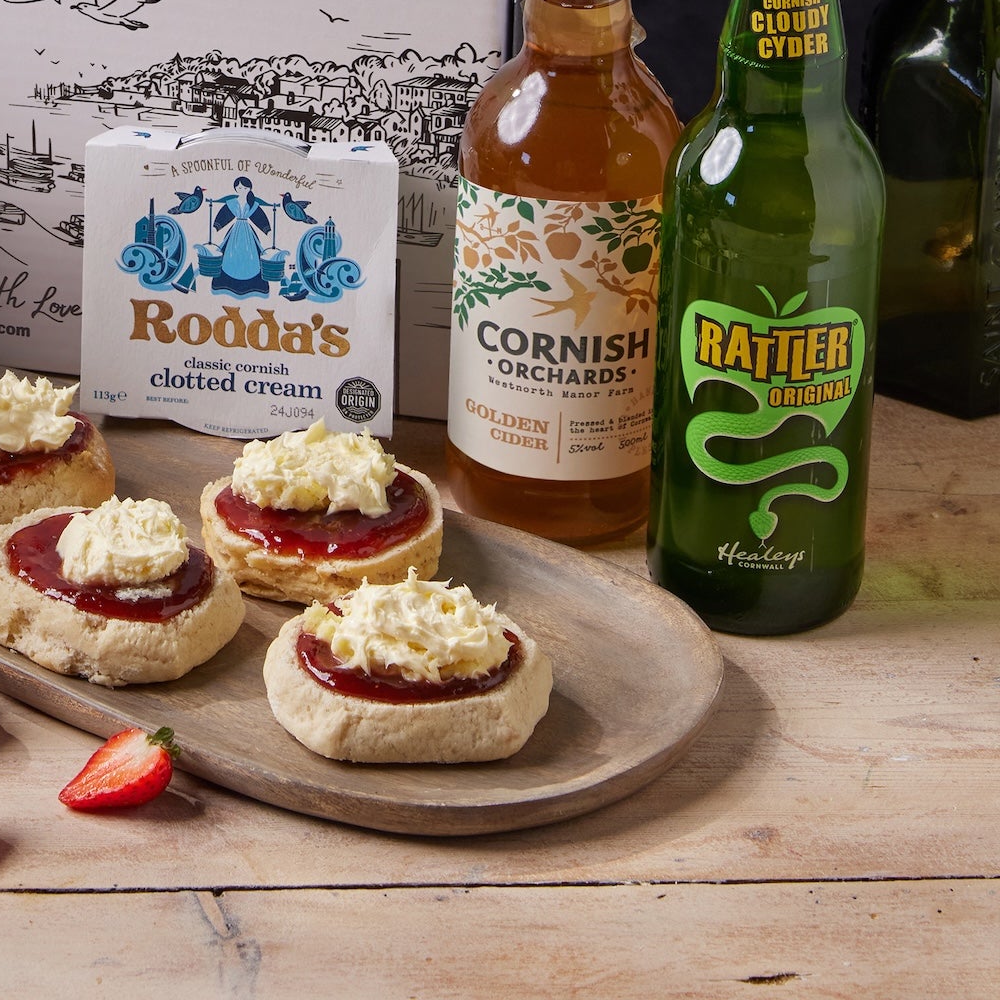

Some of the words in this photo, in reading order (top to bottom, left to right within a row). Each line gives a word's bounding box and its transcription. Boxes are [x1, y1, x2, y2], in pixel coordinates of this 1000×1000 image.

[751, 4, 829, 35] CLOUDY
[758, 32, 829, 59] CYDER
[170, 165, 179, 178] A
[181, 158, 234, 175] SPOONFUL
[237, 159, 252, 172] OF
[255, 161, 317, 190] Wonderful
[31, 286, 83, 323] Love
[129, 298, 351, 358] Rodda's
[477, 320, 650, 365] CORNISH
[697, 317, 851, 383] RATTLER
[184, 357, 232, 372] classic
[235, 361, 290, 376] cornish
[498, 358, 627, 385] ORCHARDS
[150, 367, 236, 392] clotted
[244, 377, 323, 400] cream
[488, 375, 553, 397] Westnorth
[562, 390, 601, 399] Manor
[608, 386, 634, 397] Farm
[769, 376, 851, 408] ORIGINAL
[146, 395, 163, 403] BEST
[341, 394, 375, 408] ORIGIN
[204, 423, 221, 432] KEEP
[221, 425, 269, 434] REFRIGERATED
[465, 398, 550, 435] GOLDEN
[570, 419, 605, 427] Pressed
[618, 410, 645, 423] blended
[490, 427, 549, 451] CIDER
[618, 432, 649, 450] 500ml
[717, 540, 806, 570] Healeys
[738, 560, 784, 570] CORNWALL
